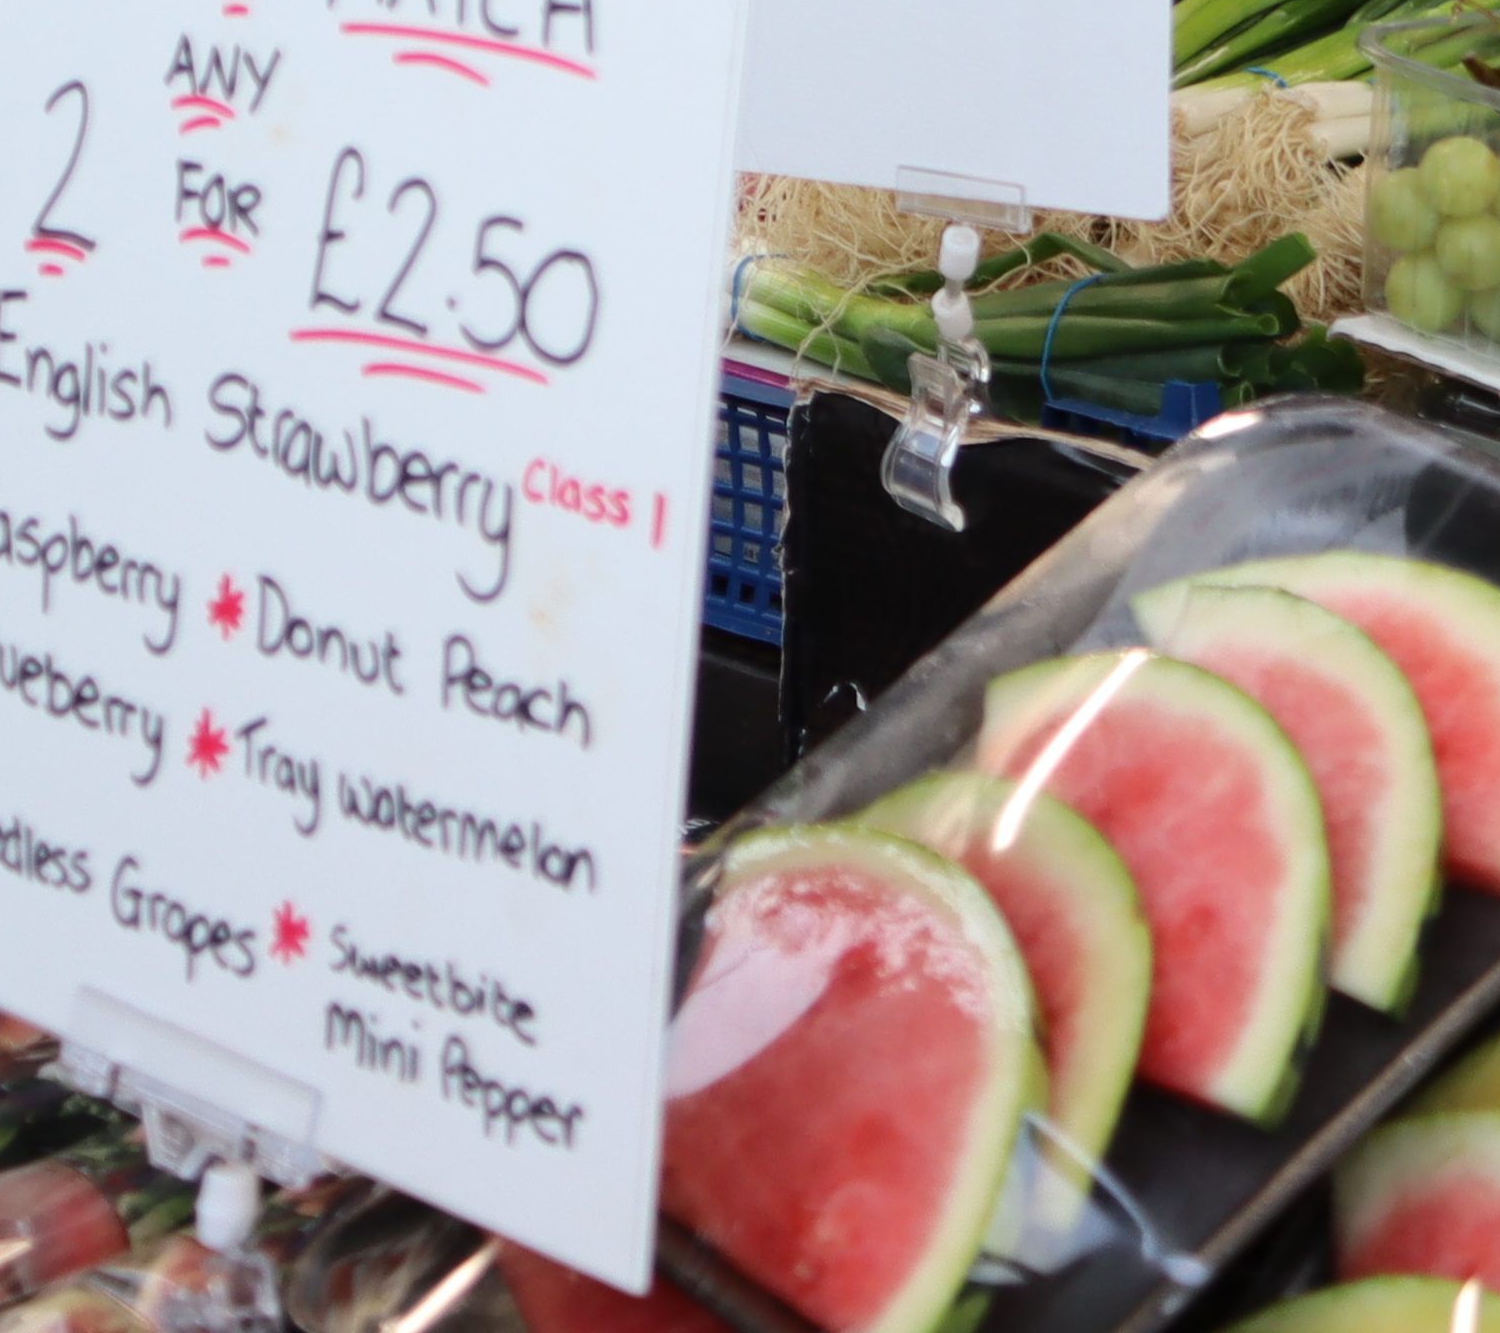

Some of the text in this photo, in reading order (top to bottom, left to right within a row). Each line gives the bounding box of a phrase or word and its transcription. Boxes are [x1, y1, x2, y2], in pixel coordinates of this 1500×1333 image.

[165, 35, 282, 115] ANY
[32, 79, 601, 368] 2 FOR £2.50
[206, 371, 515, 603] Strawberry
[522, 457, 634, 527] Class
[255, 574, 408, 697] Donut
[441, 634, 595, 749] Peach
[235, 716, 323, 837] Tray
[337, 775, 599, 894] watermelon
[111, 854, 258, 982] Grapes
[328, 924, 541, 1050] Sweetbite
[324, 1000, 587, 1151] Mini Pepper
